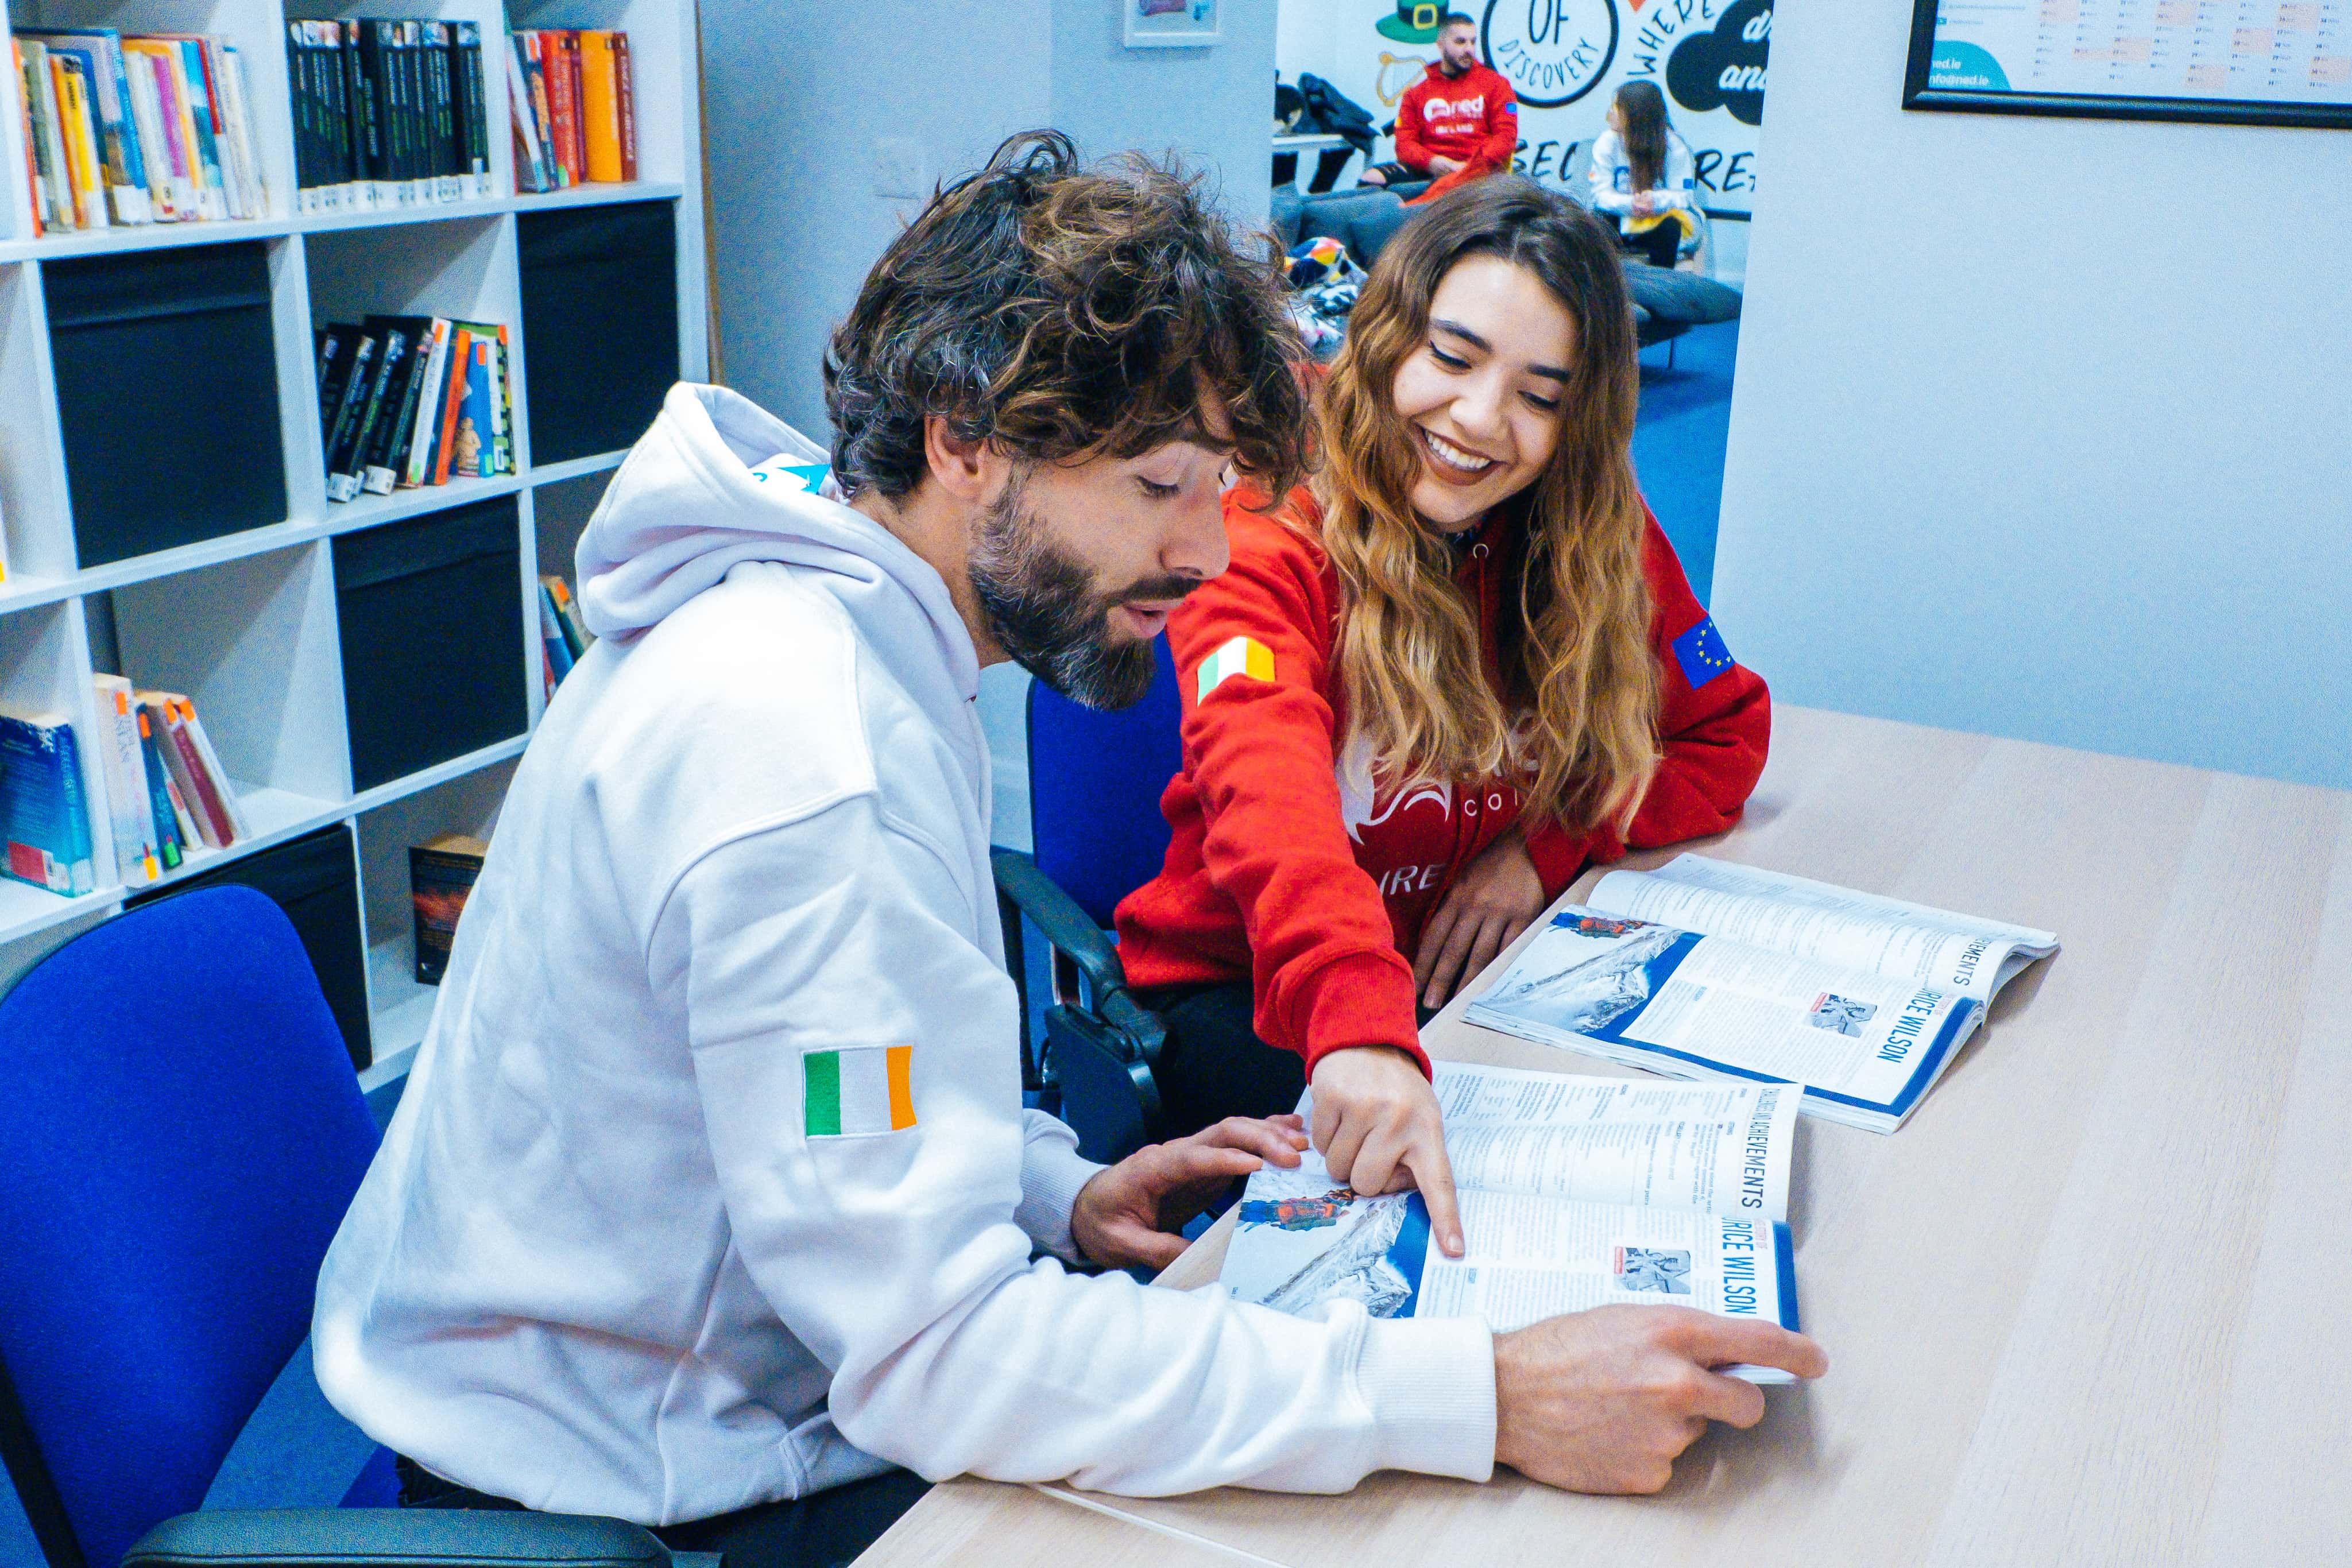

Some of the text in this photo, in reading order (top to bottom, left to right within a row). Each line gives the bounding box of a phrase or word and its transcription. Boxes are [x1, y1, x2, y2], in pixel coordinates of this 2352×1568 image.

[1529, 0, 1568, 45] OF
[1626, 0, 1715, 76] WHERE
[1498, 36, 1599, 89] DISCOVERY
[1693, 148, 1755, 192] RE
[1877, 1015, 1927, 1063] WILSON
[1742, 1121, 1771, 1209] ACHIEVEMENTS
[1723, 1256, 1757, 1314] WILSON
